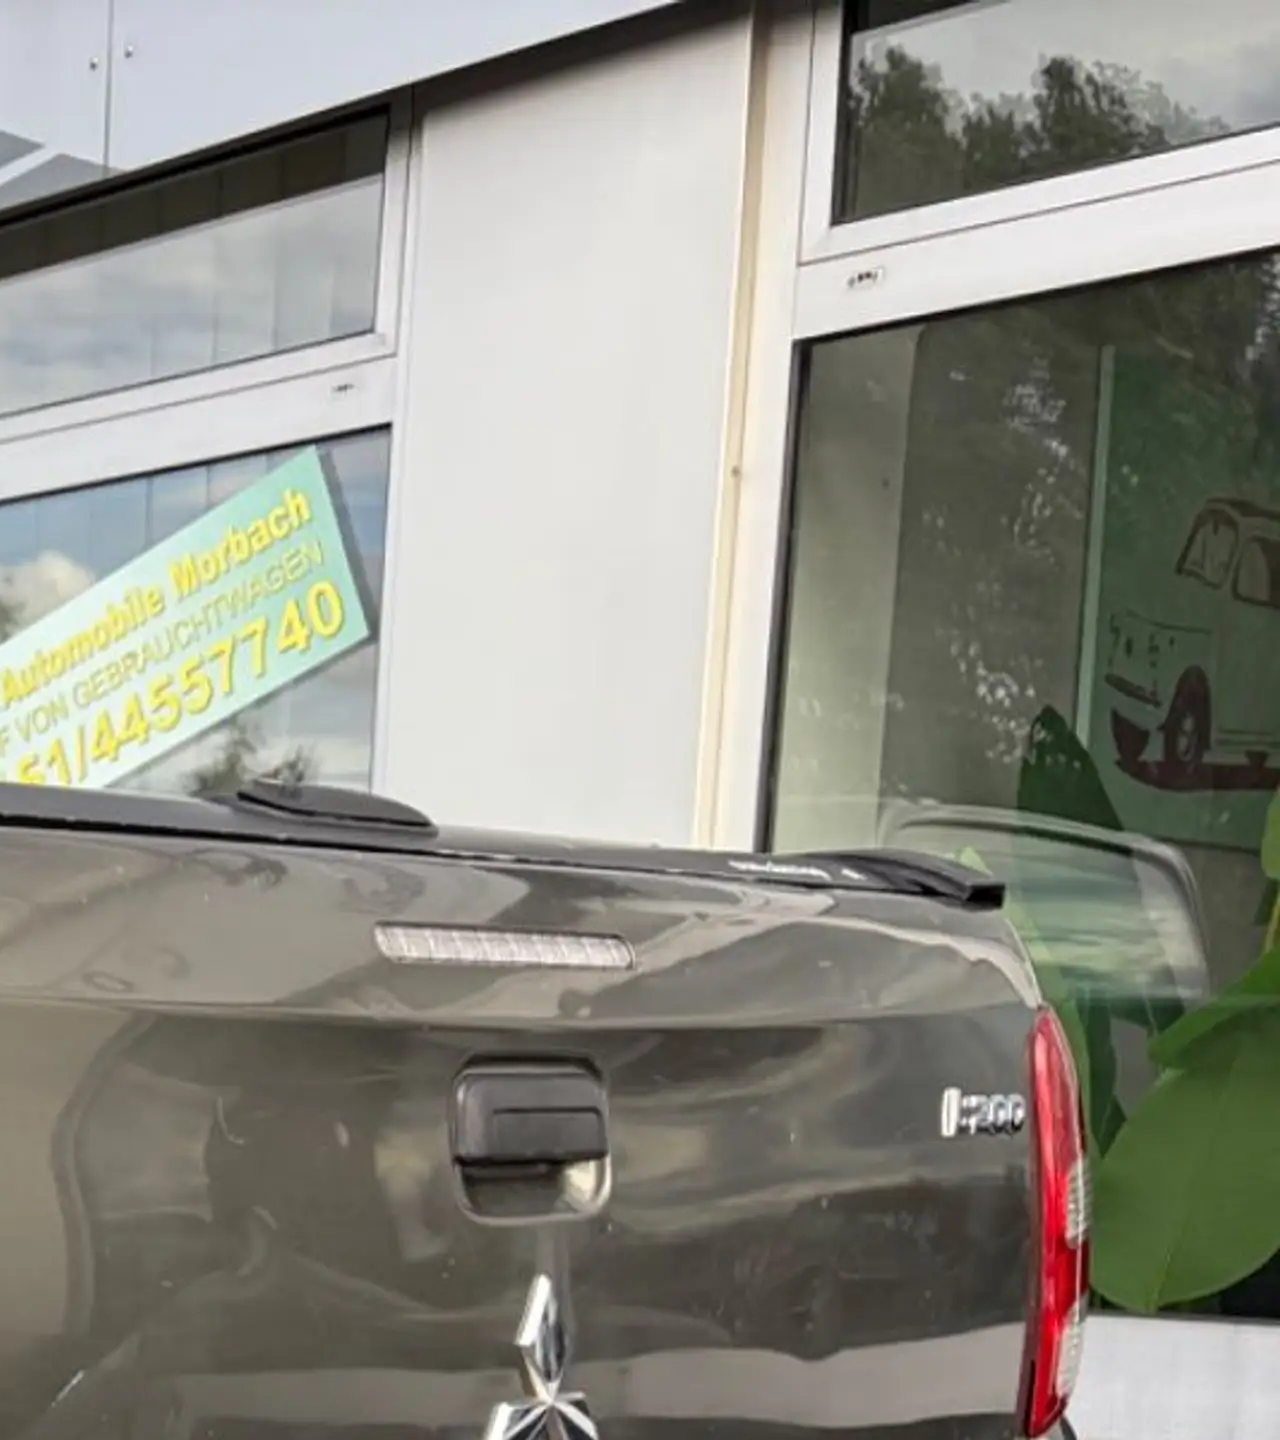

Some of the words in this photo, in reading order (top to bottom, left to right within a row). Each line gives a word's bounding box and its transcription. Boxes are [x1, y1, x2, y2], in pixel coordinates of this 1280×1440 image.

[169, 486, 315, 602] Morbach
[14, 692, 69, 742] VON
[72, 538, 326, 706] GEBRAUCHTWAGEN
